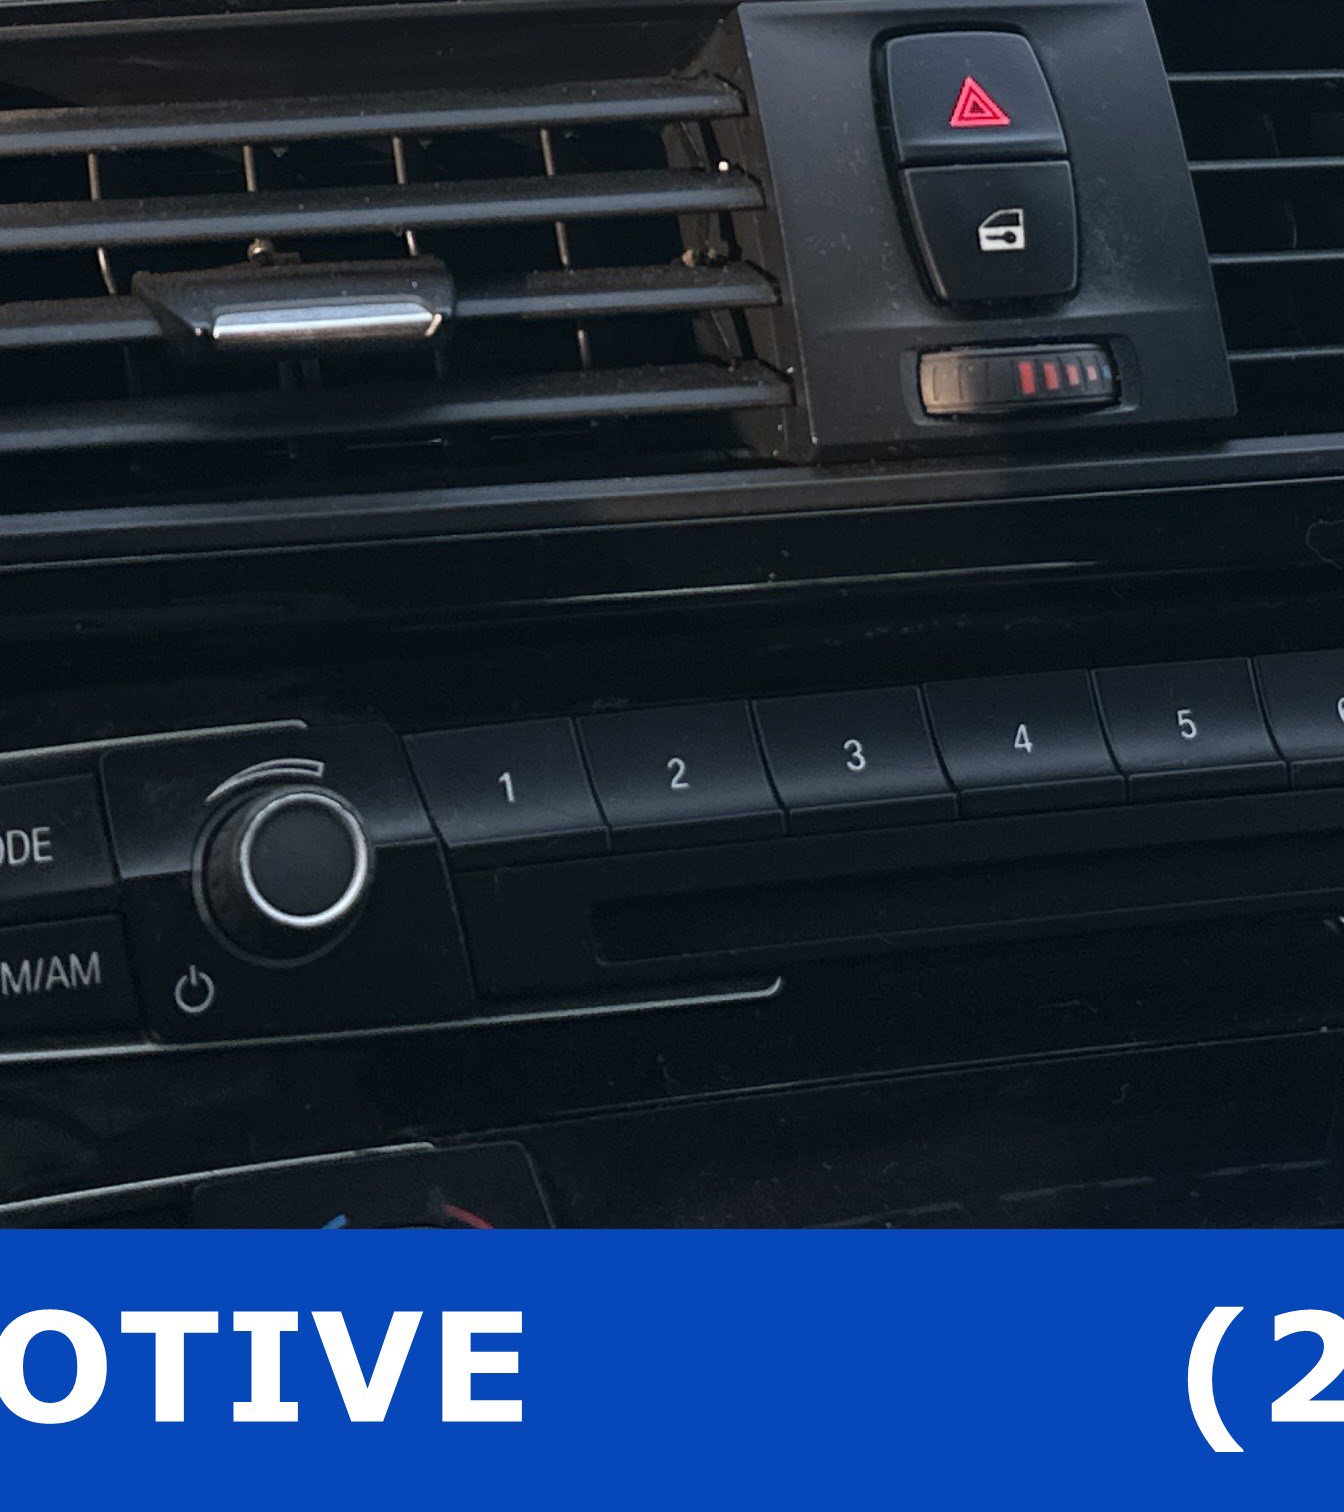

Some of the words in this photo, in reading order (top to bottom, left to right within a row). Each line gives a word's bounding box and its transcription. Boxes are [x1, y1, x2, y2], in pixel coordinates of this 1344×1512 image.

[1014, 724, 1033, 753] 4
[1177, 709, 1198, 740] 5
[843, 740, 867, 771] 3
[499, 772, 515, 802] 1
[667, 758, 690, 789] 2
